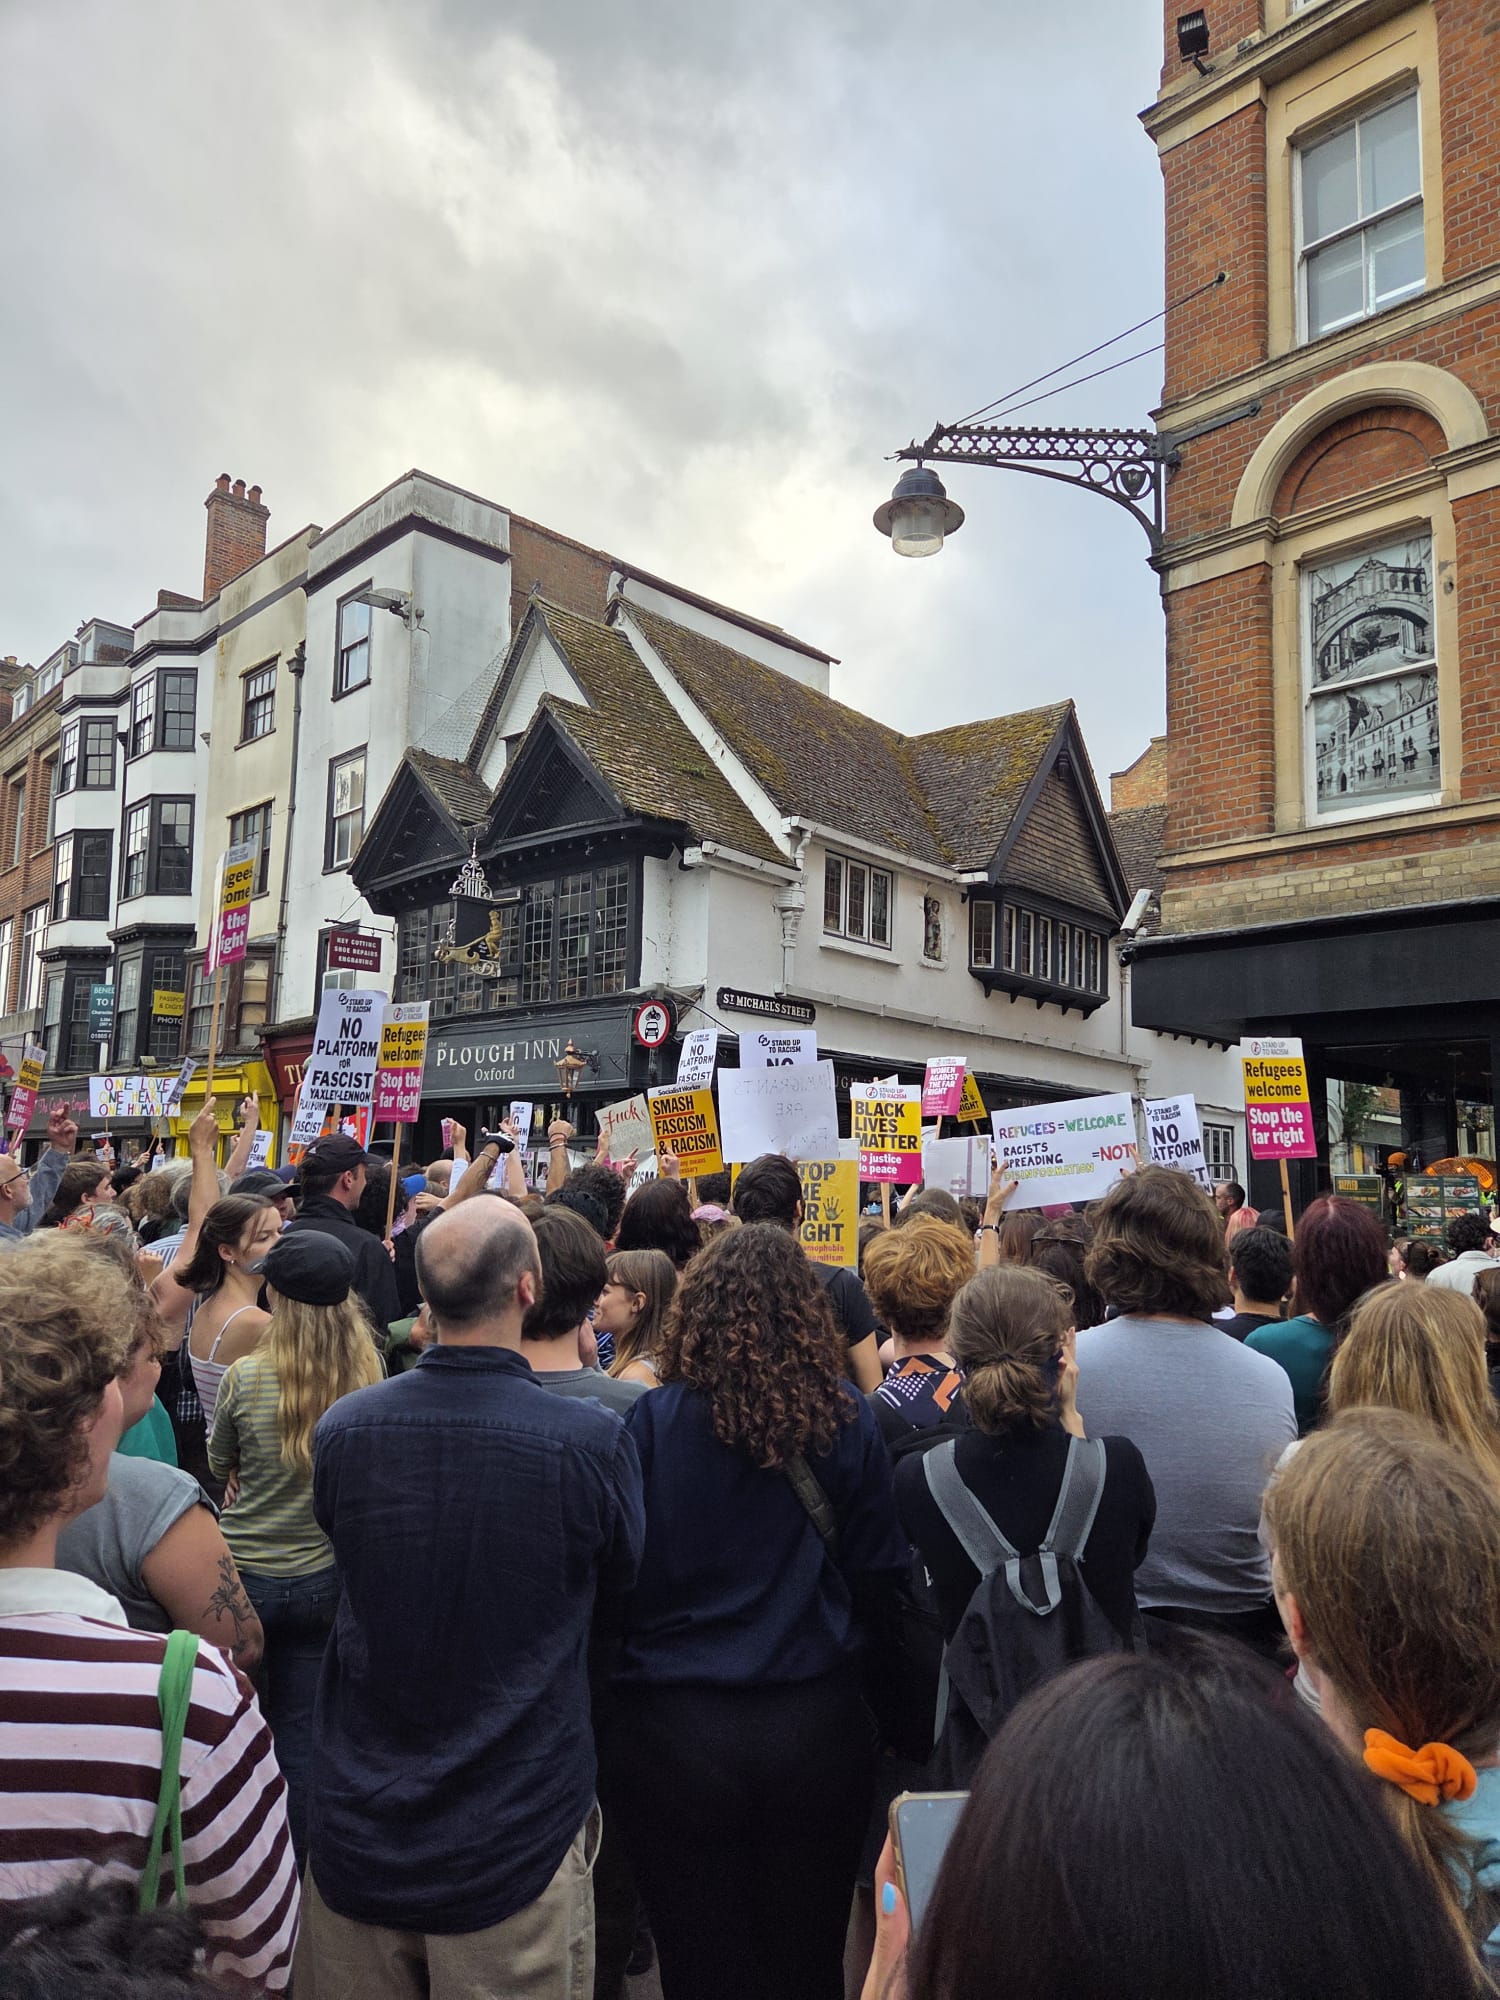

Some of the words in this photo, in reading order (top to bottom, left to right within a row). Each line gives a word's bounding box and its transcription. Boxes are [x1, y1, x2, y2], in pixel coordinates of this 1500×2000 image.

[224, 866, 253, 888] gees
[227, 912, 247, 929] the
[220, 930, 244, 954] ight
[351, 939, 377, 948] CUTTING
[334, 946, 350, 954] SHOE
[352, 948, 378, 957] REPAIRS
[338, 955, 374, 966] ENGRAVING
[96, 998, 109, 1006] TO
[736, 995, 780, 1013] MICHAEL'S
[781, 1004, 811, 1018] STREET
[339, 1017, 362, 1039] NO
[383, 1027, 426, 1045] Refugees
[316, 1039, 379, 1058] PLATFORM
[383, 1046, 423, 1062] welcome
[436, 1043, 516, 1066] PLOUGH
[524, 1038, 560, 1060] INN
[689, 1044, 704, 1056] NO
[339, 1058, 351, 1070] FOR
[680, 1055, 714, 1068] PLATFORM
[474, 1066, 515, 1081] Oxford
[678, 1072, 711, 1083] FASCIST
[930, 1066, 956, 1075] WOMEN
[930, 1073, 959, 1081] AGAINST
[1245, 1062, 1302, 1080] Refugees
[105, 1078, 133, 1091] ONE
[141, 1078, 171, 1092] LOVE
[311, 1070, 373, 1089] FASCIST
[380, 1071, 402, 1091] Stop
[405, 1071, 421, 1088] the
[99, 1090, 124, 1103] ONE
[131, 1090, 164, 1103] HEART
[310, 1088, 371, 1103] YAXLEY-LENNON
[657, 1086, 682, 1096] Socialist
[682, 1084, 702, 1093] Worker
[927, 1088, 948, 1096] RIGHT
[1247, 1081, 1301, 1097] welcome
[300, 1098, 328, 1111] PLATFORM
[379, 1092, 395, 1108] far
[396, 1090, 419, 1111] right
[652, 1095, 694, 1116] SMASH
[99, 1103, 122, 1116] ONE
[855, 1100, 905, 1118] BLACK
[1153, 1107, 1172, 1115] STAND
[1161, 1111, 1182, 1121] RACISM
[602, 1100, 642, 1136] fuck
[655, 1114, 706, 1136] FASCISM
[854, 1117, 898, 1133] LIVES
[1249, 1107, 1279, 1128] Stop
[1280, 1107, 1303, 1124] the
[294, 1121, 321, 1134] FASCIST
[999, 1121, 1056, 1139] REFUGEES
[1151, 1124, 1179, 1146] NO
[659, 1140, 668, 1155] &
[671, 1133, 717, 1154] RACISM
[855, 1132, 918, 1149] MATTER
[1252, 1128, 1270, 1144] far
[1272, 1127, 1305, 1147] right
[1003, 1142, 1048, 1157] RACISTS
[1152, 1139, 1201, 1161] ATFORM
[869, 1152, 902, 1164] justice
[798, 1162, 836, 1181] TOP
[869, 1165, 898, 1175] peace
[1004, 1162, 1095, 1181] DISINFORMATION
[631, 1171, 654, 1188] CISM
[803, 1223, 845, 1242] GHT
